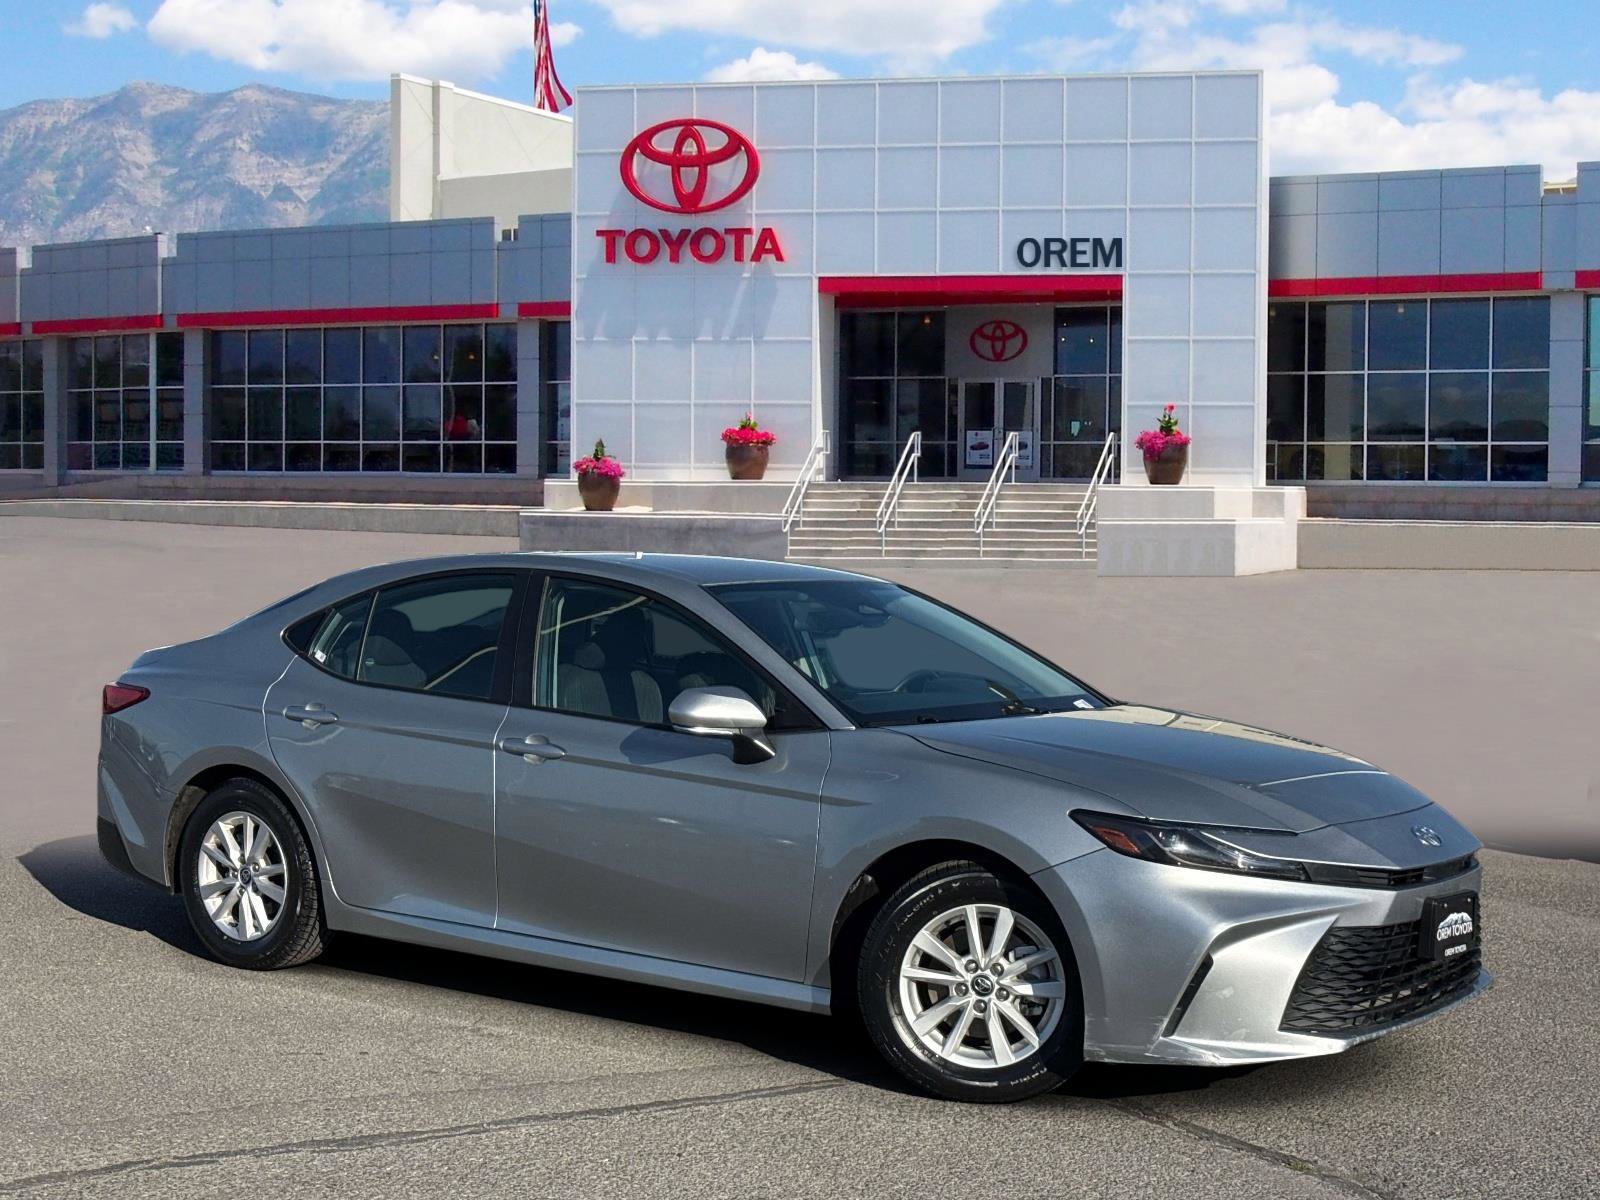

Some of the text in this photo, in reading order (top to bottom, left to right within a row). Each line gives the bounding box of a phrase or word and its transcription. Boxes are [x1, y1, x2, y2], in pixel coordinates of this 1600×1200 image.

[595, 227, 785, 264] TOYOTA
[1017, 237, 1123, 268] OREM
[1437, 922, 1473, 941] OREM TOYOTA
